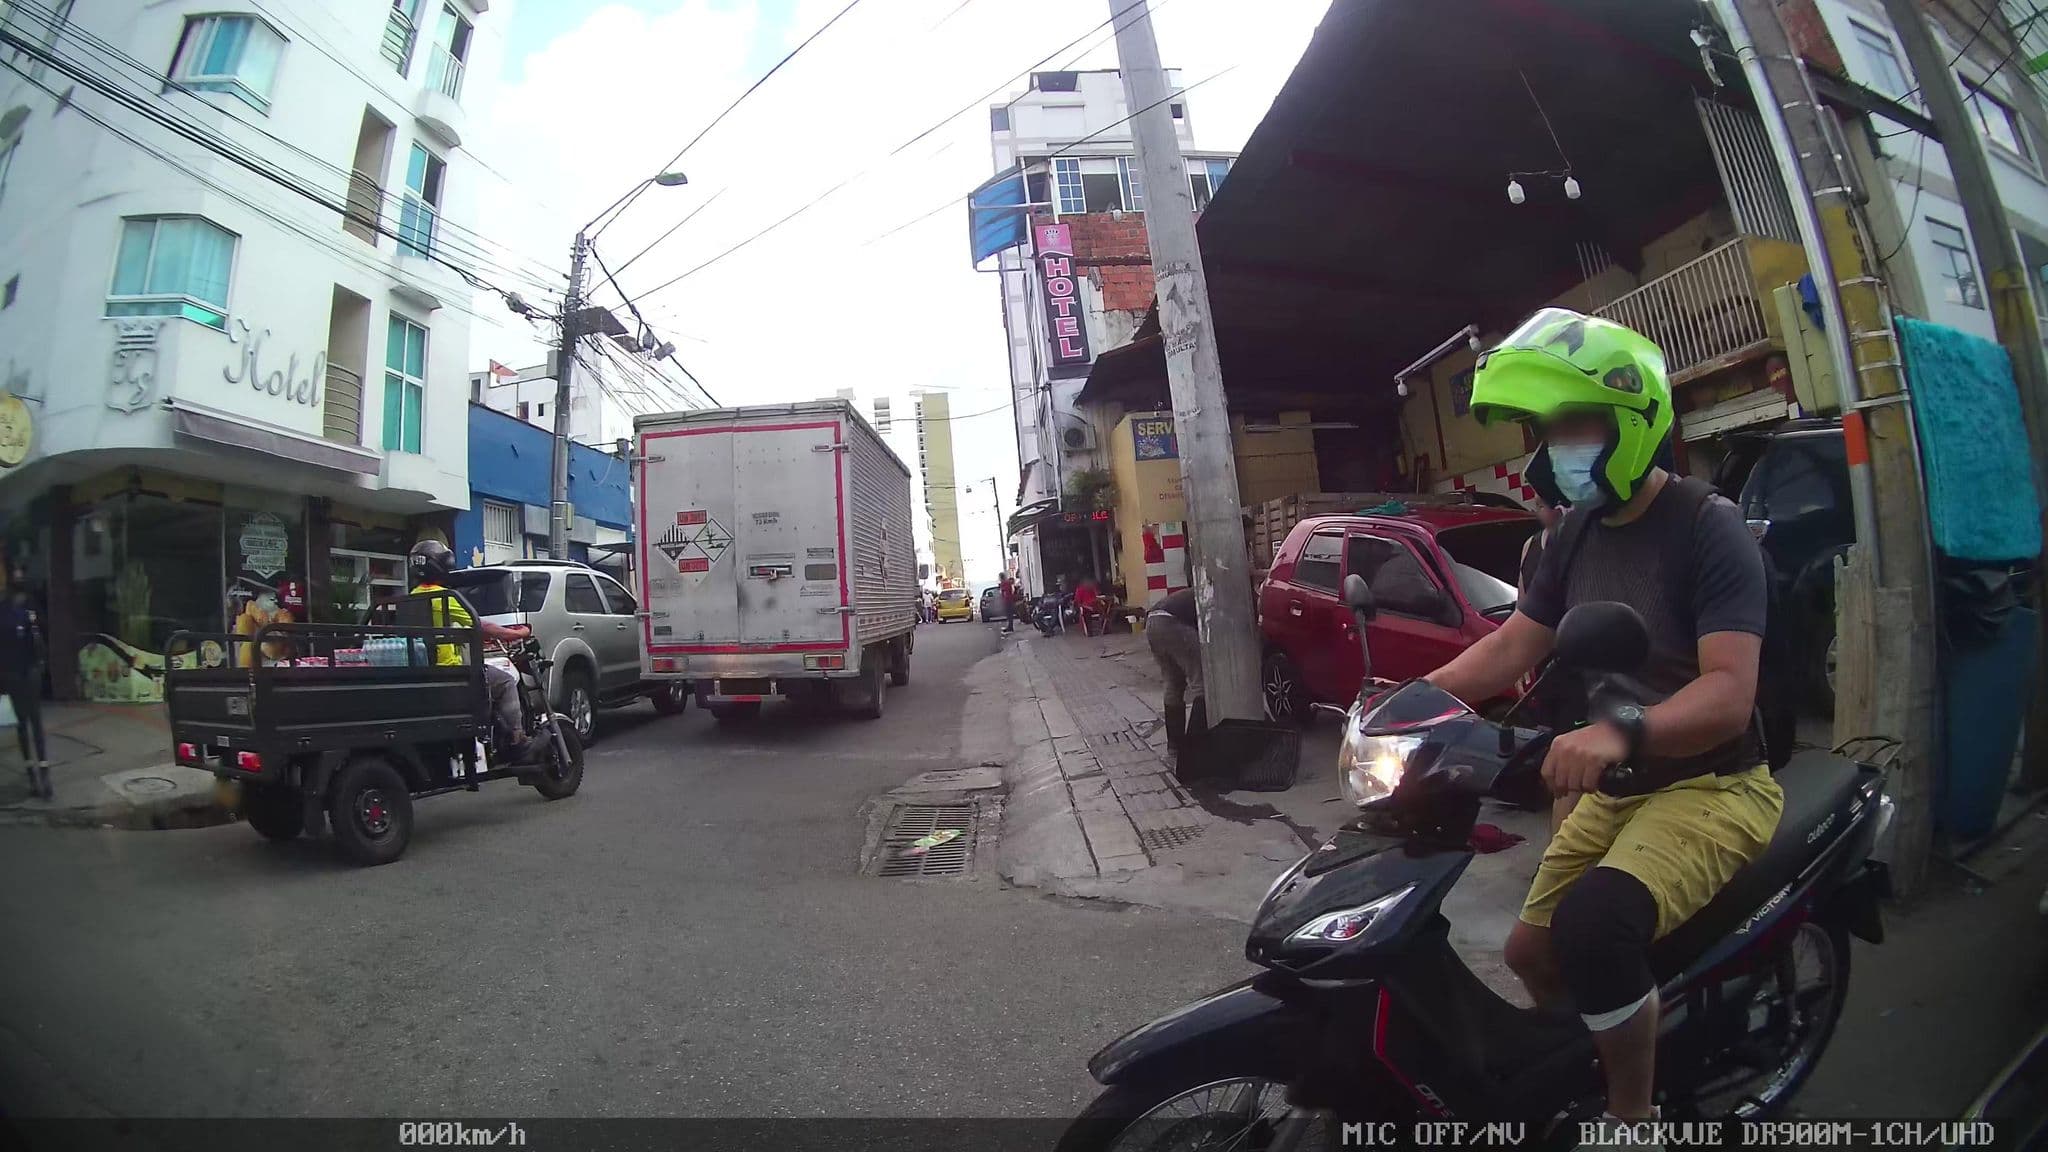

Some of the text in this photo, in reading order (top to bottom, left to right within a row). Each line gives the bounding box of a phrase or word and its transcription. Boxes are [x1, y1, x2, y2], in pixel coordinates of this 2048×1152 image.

[1044, 257, 1083, 358] HOTEL
[223, 318, 326, 407] Hotel
[1752, 881, 1794, 922] VICTORY
